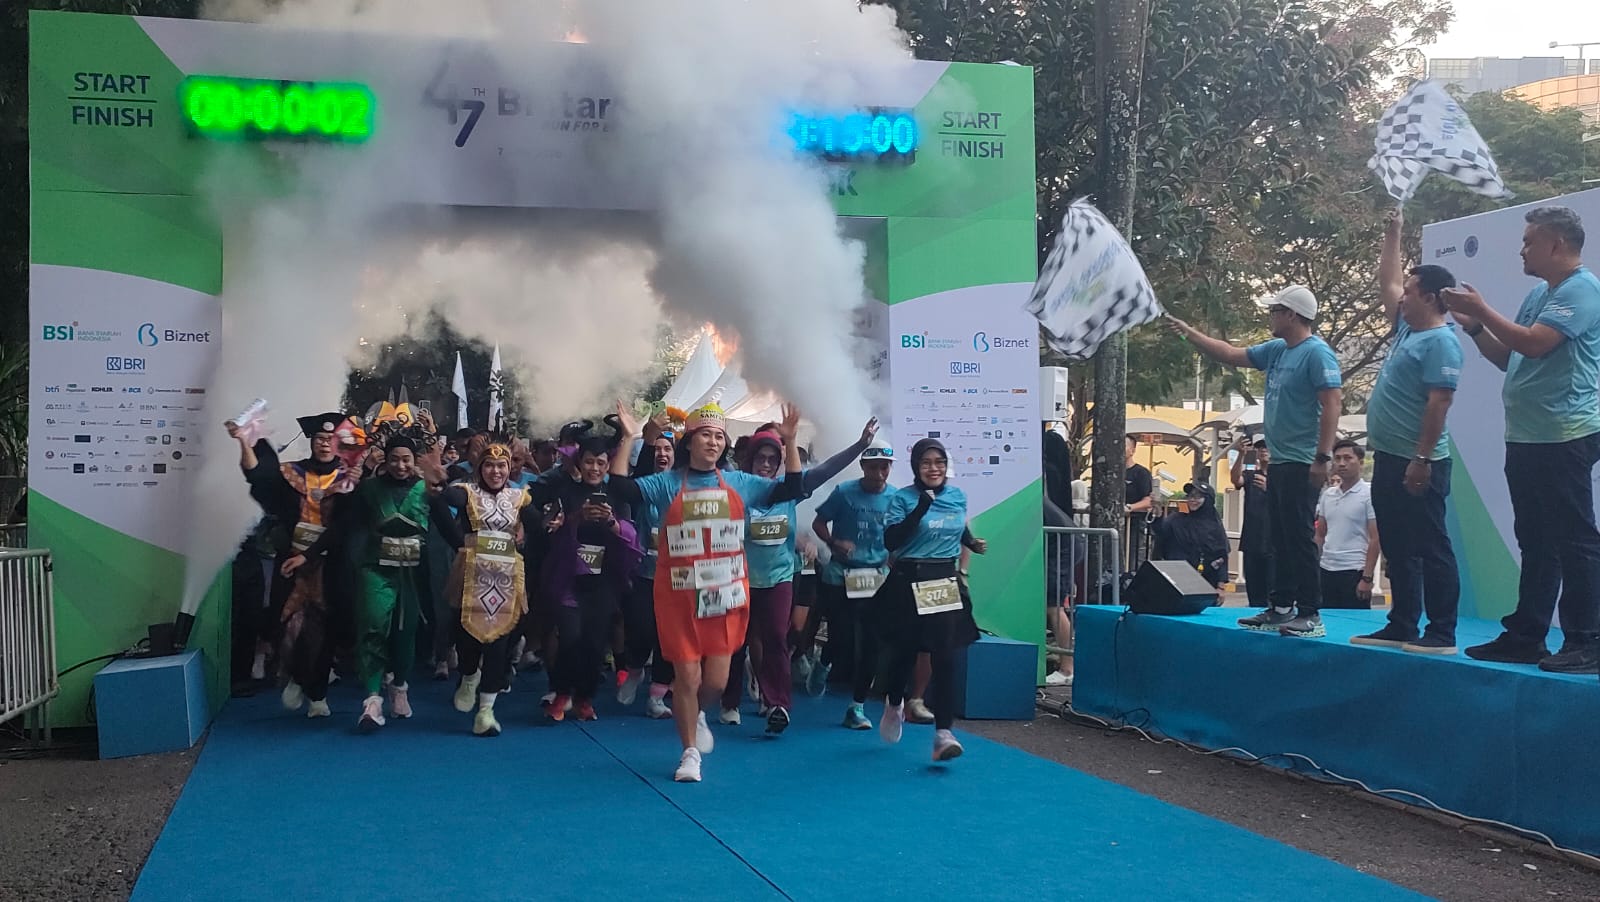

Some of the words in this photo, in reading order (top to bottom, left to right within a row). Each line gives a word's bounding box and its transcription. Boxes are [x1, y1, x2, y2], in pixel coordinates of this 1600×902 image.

[74, 72, 151, 94] START
[471, 87, 487, 96] TH
[72, 105, 153, 128] FINISH
[190, 86, 368, 135] 00:00:02
[943, 111, 1002, 129] START
[942, 140, 1004, 159] FINISH
[43, 325, 74, 341] BSI
[164, 329, 209, 343] Biznet
[901, 335, 926, 349] BSI
[994, 337, 1029, 348] Biznet
[124, 358, 146, 371] BRI
[963, 362, 981, 374] BRI
[760, 524, 781, 535] 5128
[486, 540, 508, 552] 5753
[926, 588, 949, 602] 5174
